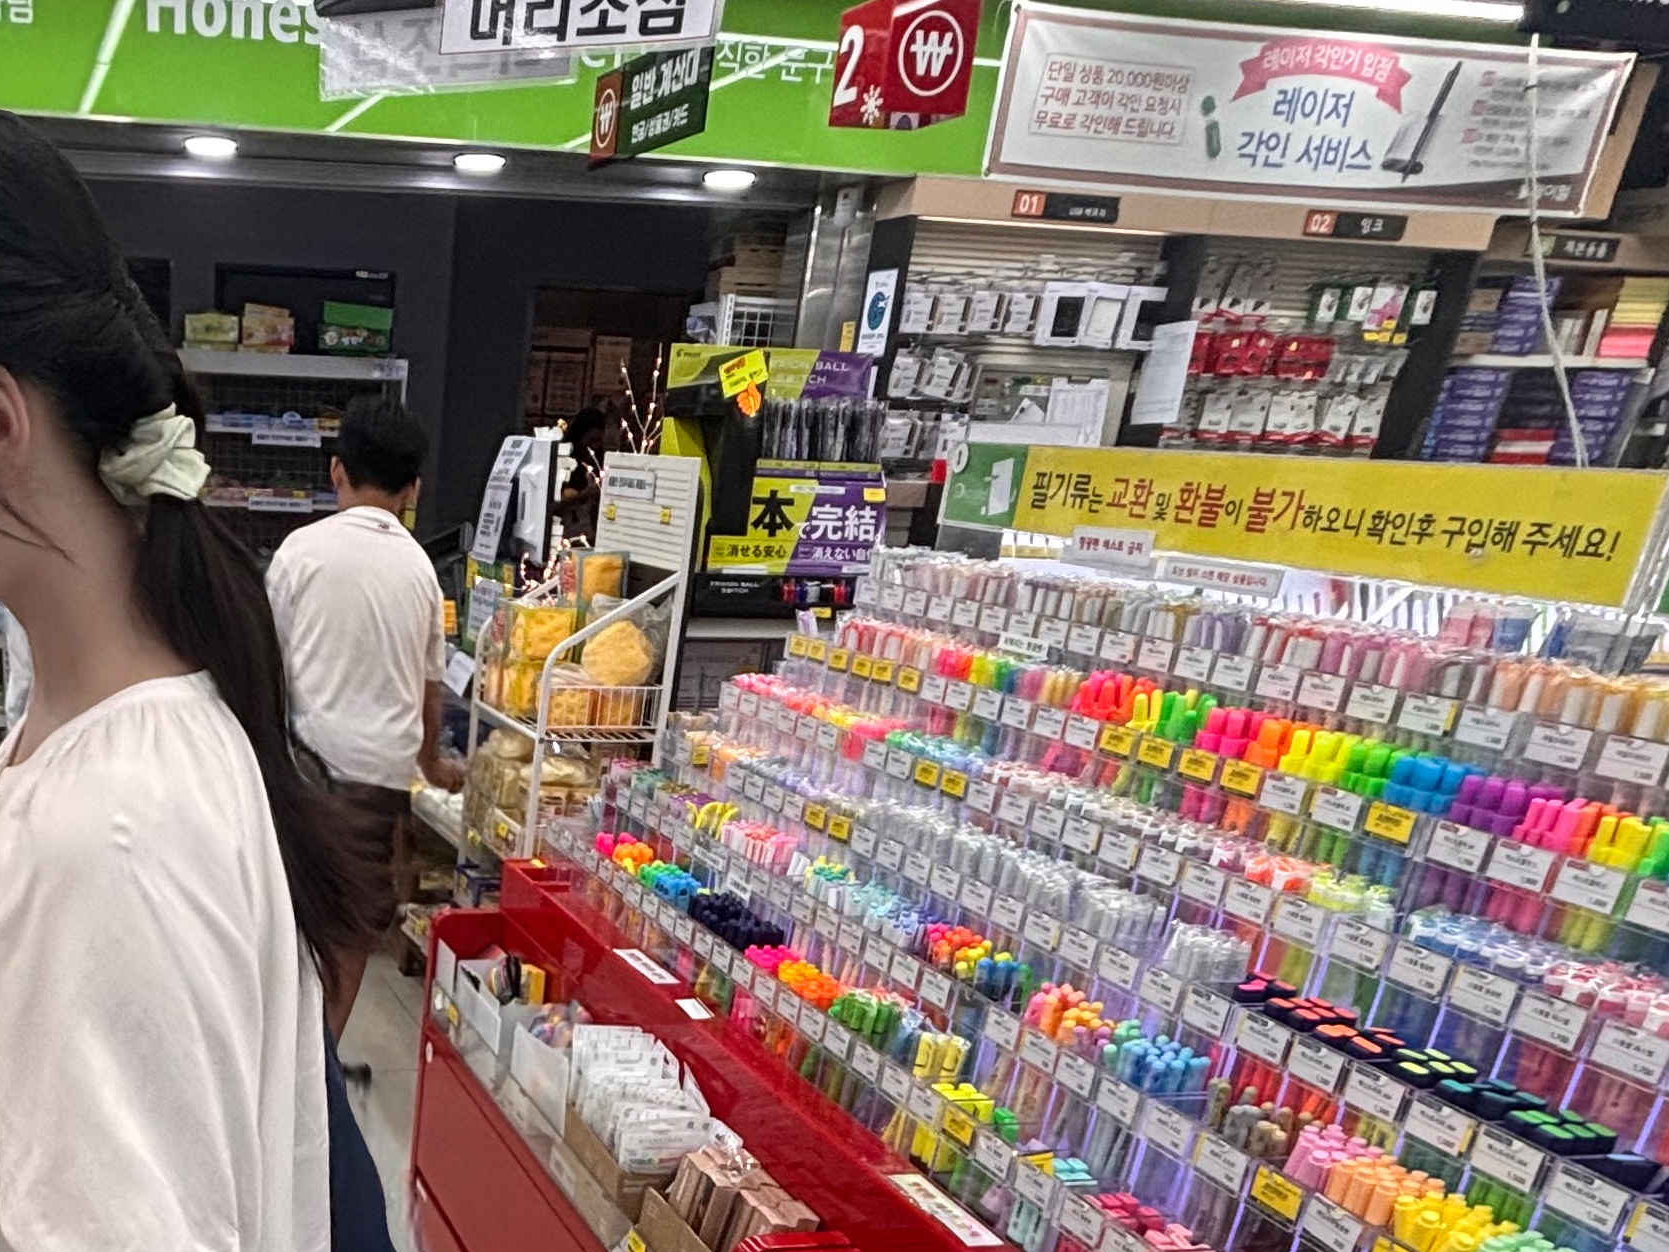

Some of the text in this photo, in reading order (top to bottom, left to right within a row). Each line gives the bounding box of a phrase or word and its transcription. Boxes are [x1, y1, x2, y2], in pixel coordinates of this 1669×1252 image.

[834, 24, 865, 108] 2
[1260, 46, 1315, 74] 레이저
[629, 66, 661, 111] 일반
[658, 48, 700, 103] 계산대
[1047, 61, 1077, 83] 단일
[1078, 64, 1104, 87] 상품
[1040, 86, 1072, 107] 구매
[1073, 89, 1116, 111] 고객이
[1272, 86, 1357, 129] 레이저
[1033, 113, 1077, 133] 무료로
[1078, 117, 1123, 137] 각인해
[1236, 130, 1374, 173] 각인 서비스
[1018, 194, 1039, 213] 01
[1310, 214, 1331, 233] 02
[1030, 470, 1104, 514] 필기류는
[1105, 477, 1154, 520] 교환
[1152, 492, 1172, 521] 및
[1173, 481, 1245, 528] 환불이
[1439, 516, 1520, 554] 구입해
[1520, 521, 1622, 563] 주세요!
[1126, 540, 1144, 556] 금지
